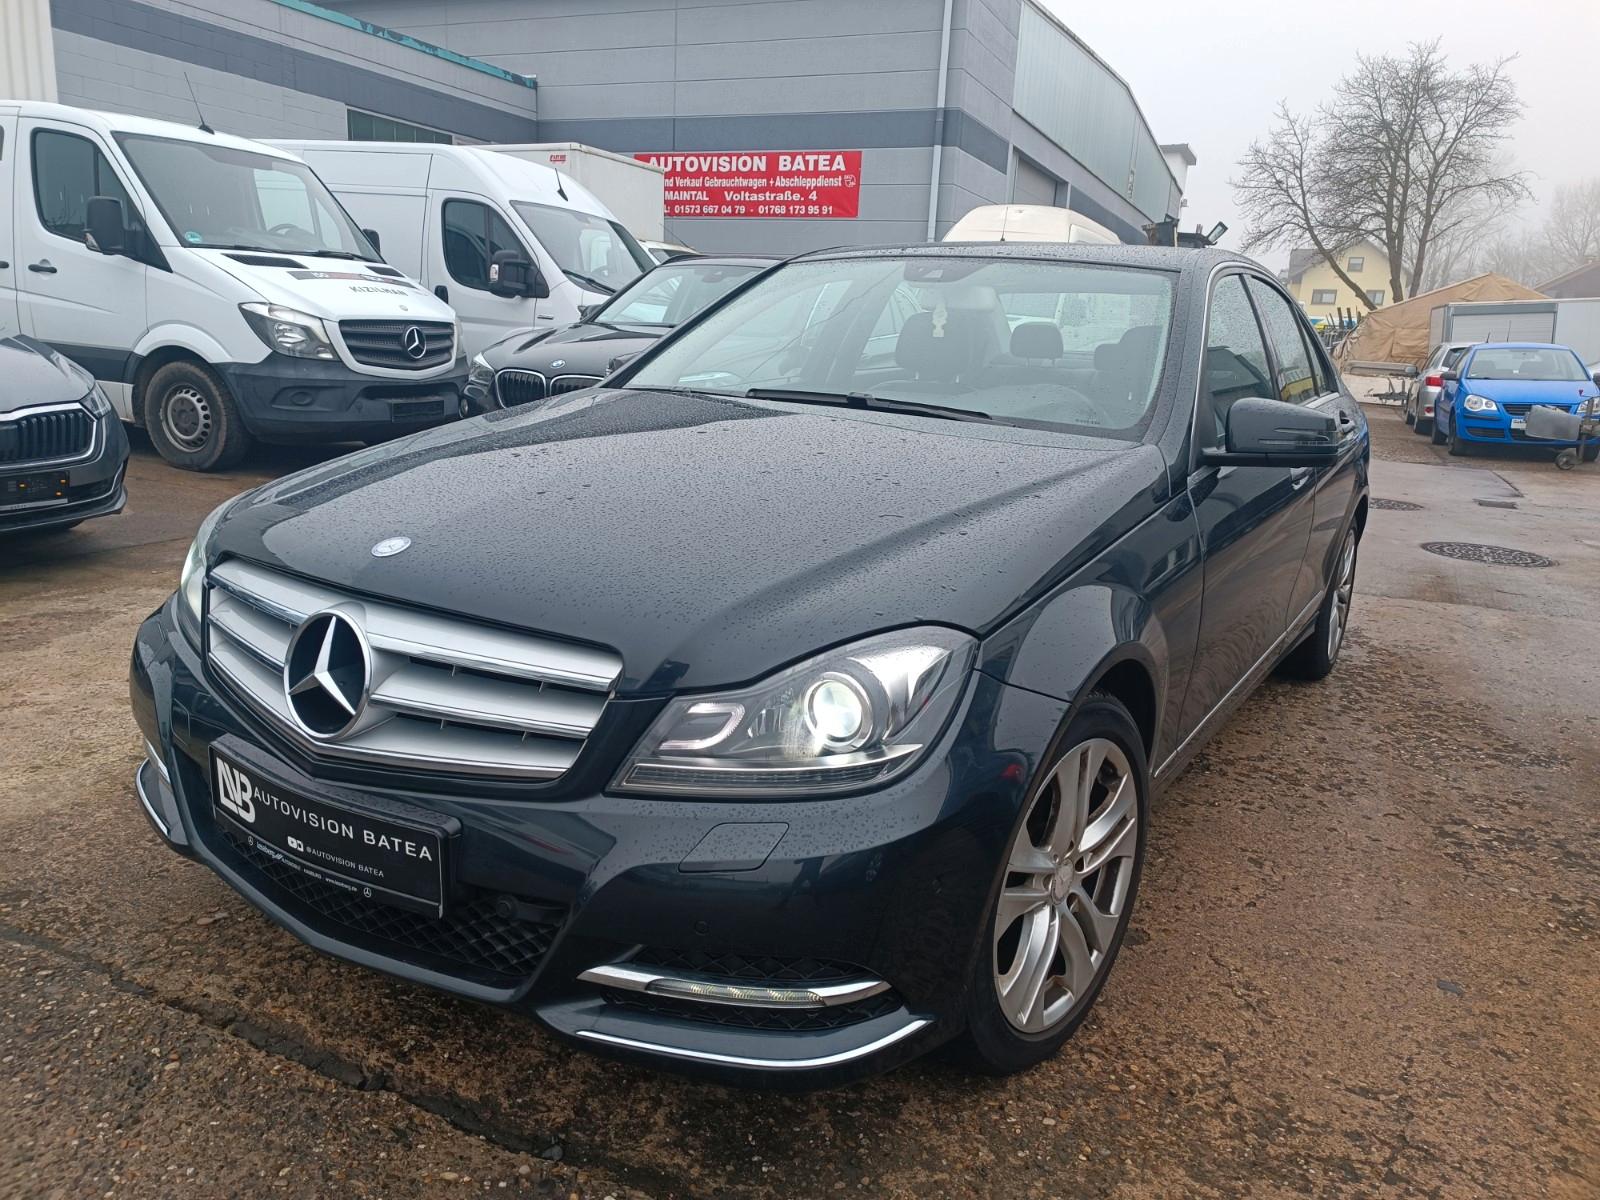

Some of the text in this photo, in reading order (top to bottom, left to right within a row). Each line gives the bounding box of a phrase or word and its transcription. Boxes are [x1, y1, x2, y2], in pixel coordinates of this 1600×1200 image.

[778, 154, 846, 171] BATEA
[664, 176, 674, 187] nd
[675, 176, 703, 187] Verkauf
[704, 175, 767, 189] Gebrauchtwagen
[664, 190, 709, 201] MAINTAL
[808, 190, 817, 201] 4
[674, 204, 700, 214] 01573
[702, 205, 718, 214] 667
[721, 205, 732, 214] 04
[734, 205, 745, 214] 79
[758, 205, 786, 214] 01768
[789, 205, 805, 214] 173
[807, 206, 819, 214] 95
[822, 206, 833, 214] 91
[254, 786, 432, 861] AUTOVISION BATEA
[358, 863, 384, 878] BATEA
